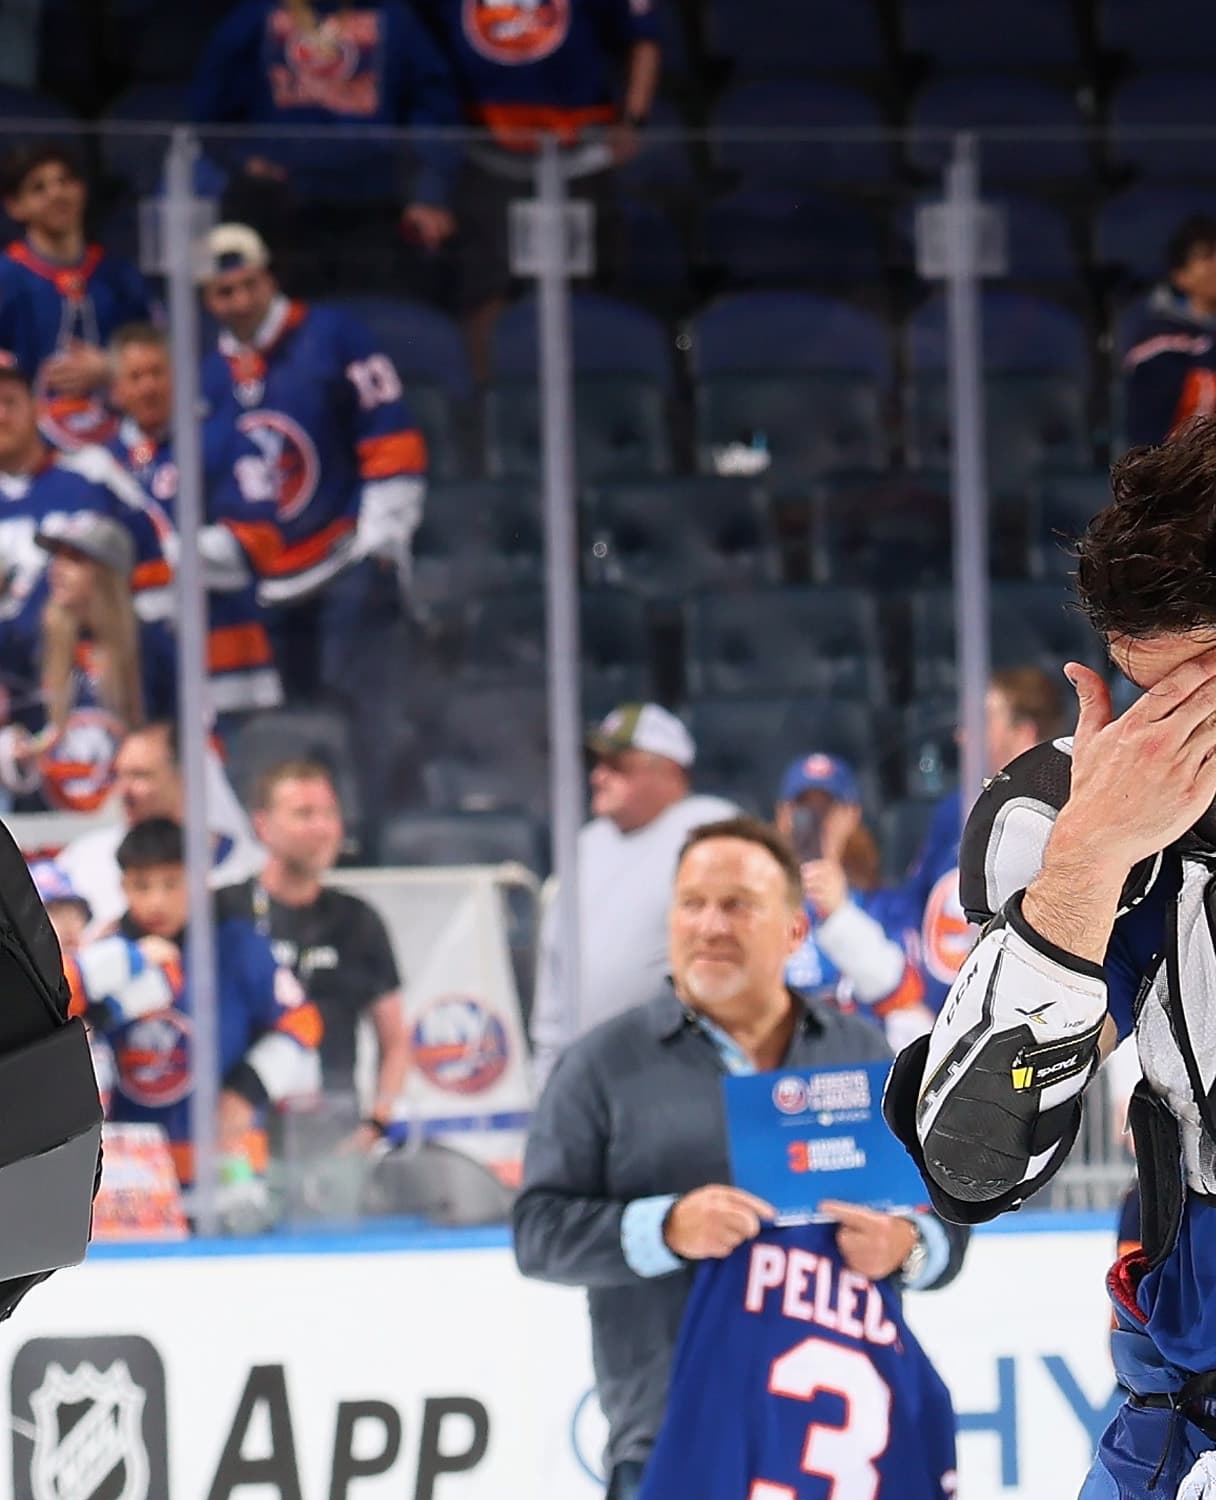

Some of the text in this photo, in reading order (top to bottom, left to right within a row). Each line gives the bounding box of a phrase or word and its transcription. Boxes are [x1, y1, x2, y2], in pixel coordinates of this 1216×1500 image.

[946, 962, 979, 1026] CCM
[788, 1141, 809, 1173] 3
[744, 1243, 902, 1350] PELEC
